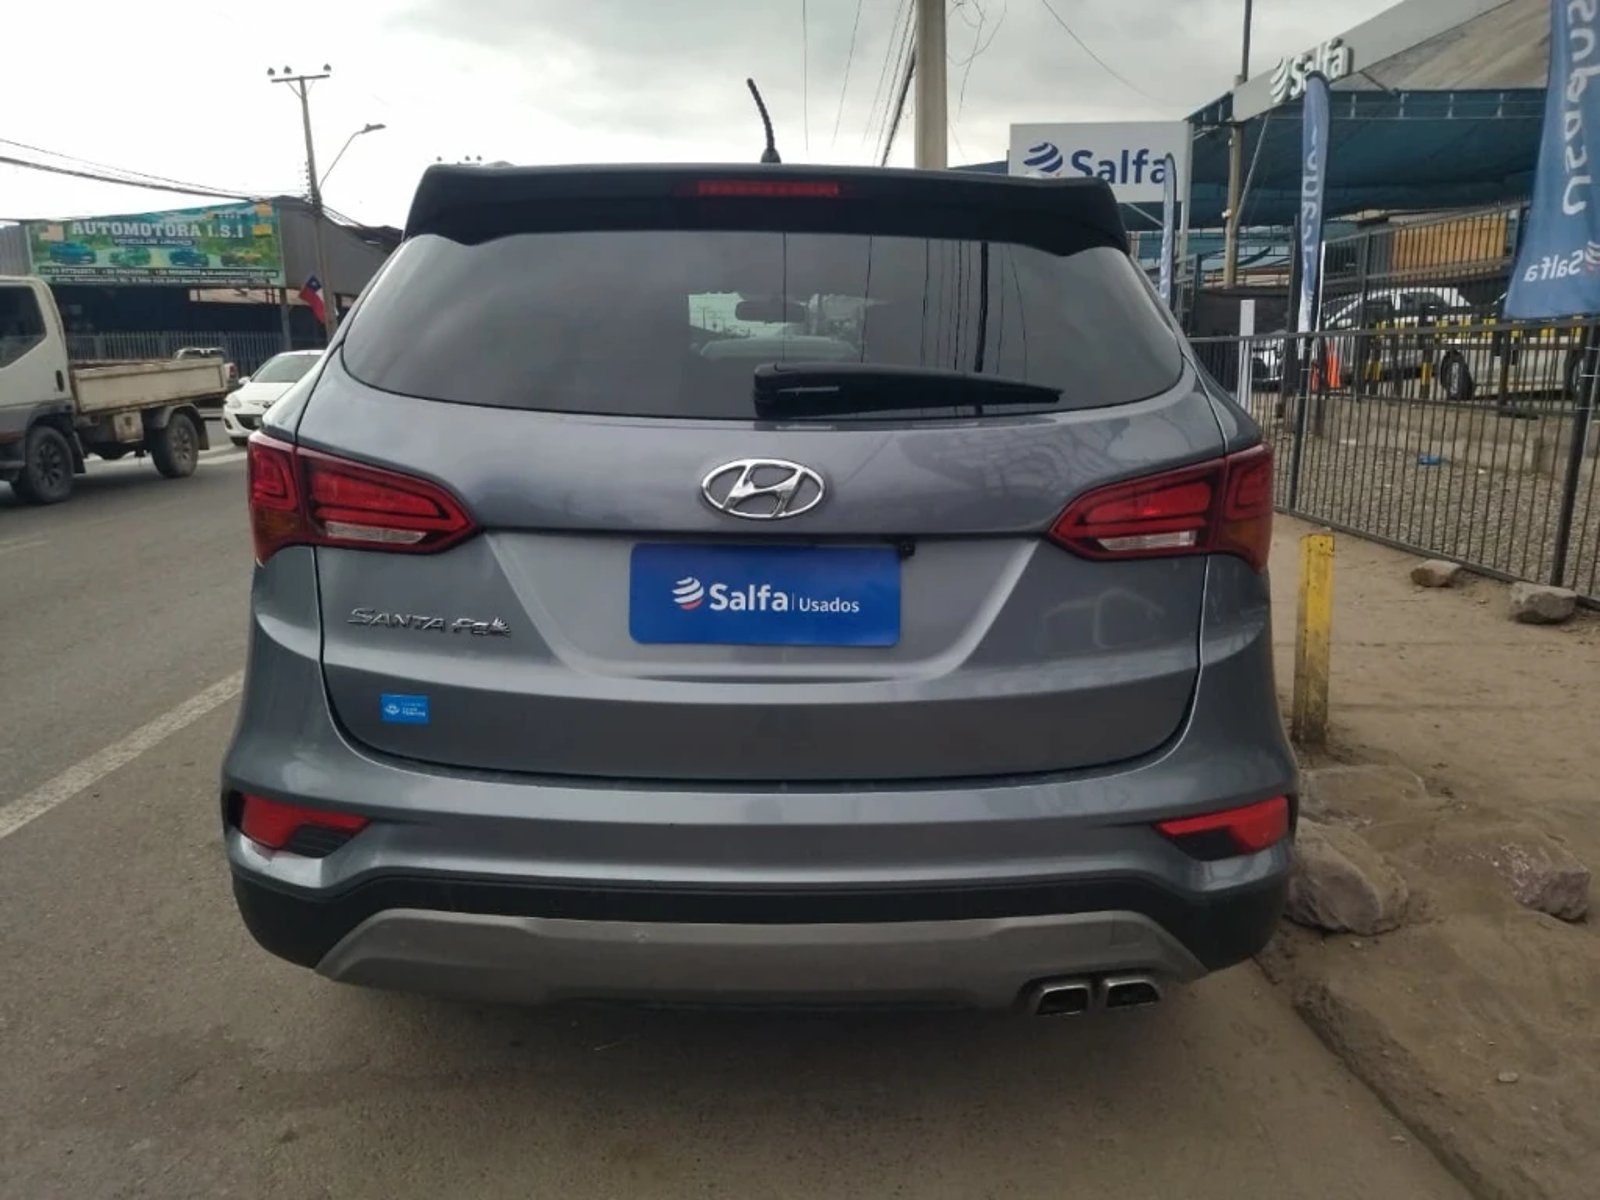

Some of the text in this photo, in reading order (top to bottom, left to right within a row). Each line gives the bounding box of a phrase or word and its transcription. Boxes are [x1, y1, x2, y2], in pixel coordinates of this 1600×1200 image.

[1071, 148, 1166, 185] Salfa
[72, 221, 202, 238] AUTOMOTORA
[709, 582, 860, 613] Salfa Usados
[347, 607, 446, 633] SANTA
